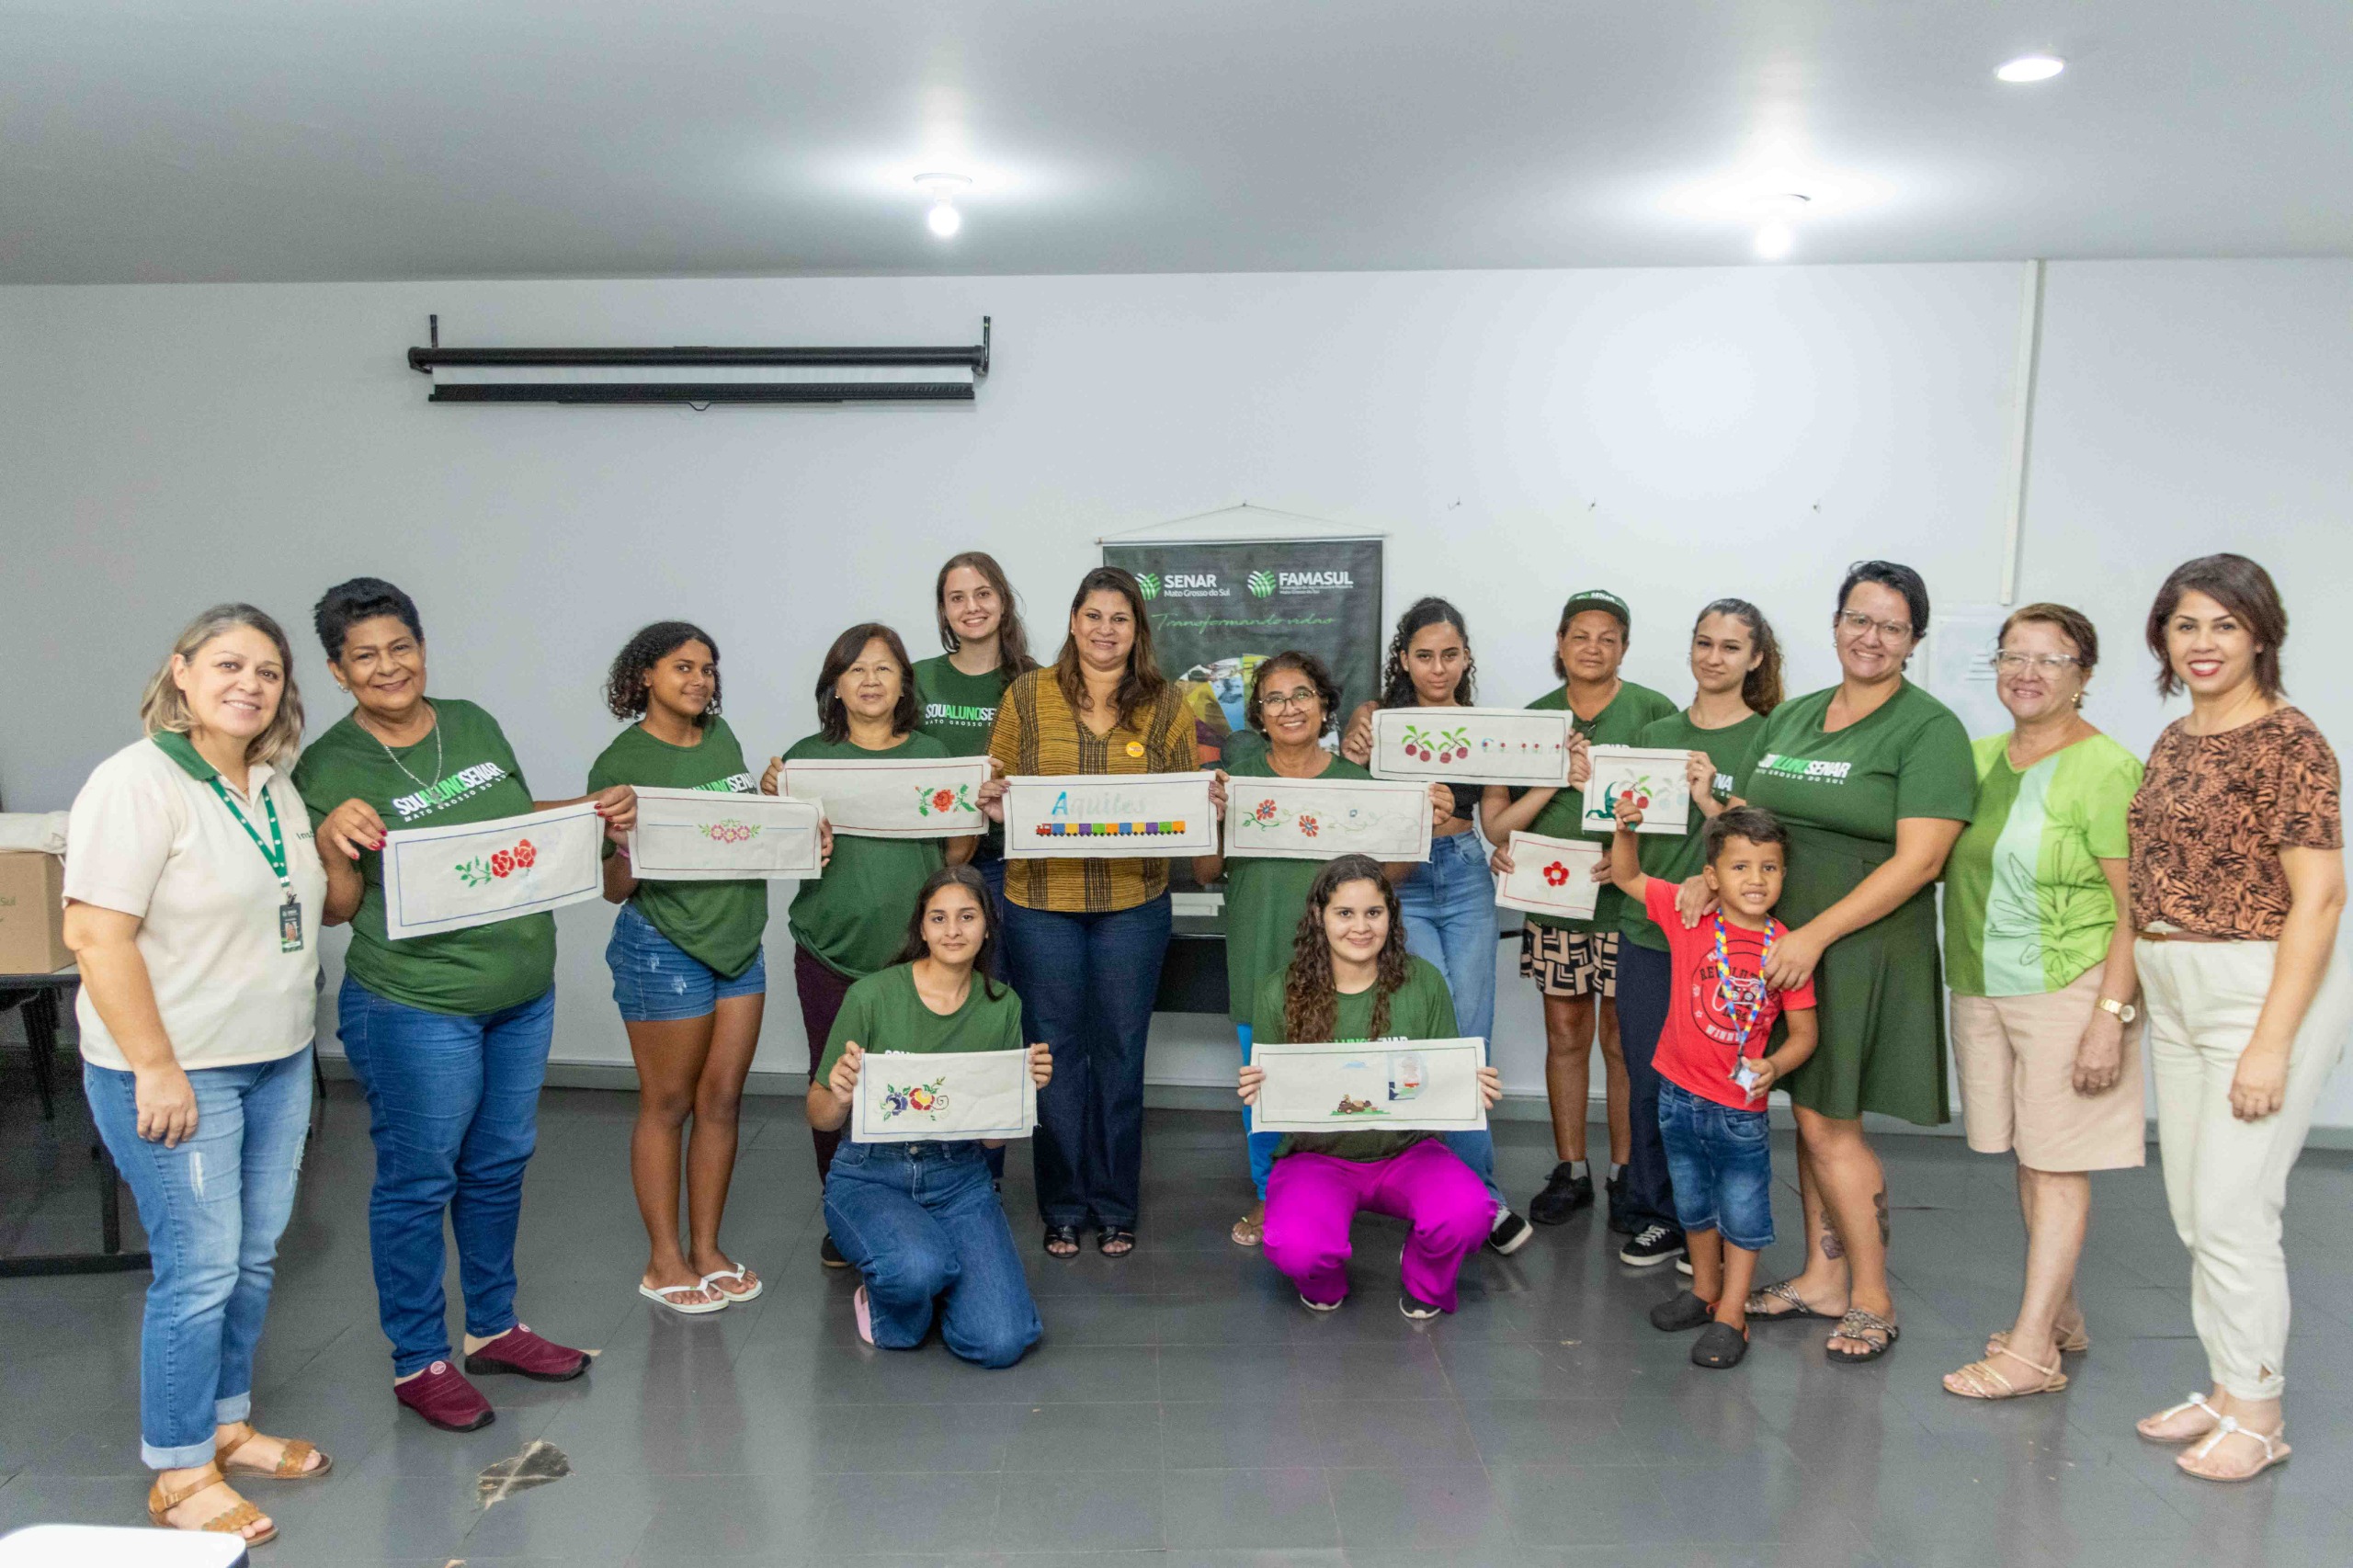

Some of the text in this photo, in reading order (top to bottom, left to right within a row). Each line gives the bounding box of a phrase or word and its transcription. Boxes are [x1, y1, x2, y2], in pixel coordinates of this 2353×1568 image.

[1164, 574, 1217, 588] SENAR
[1279, 571, 1354, 586] FAMASUL
[1164, 588, 1231, 597] Mato Grosso do Sul
[925, 703, 997, 721] SOUALUNOSE
[404, 808, 433, 823] MATO
